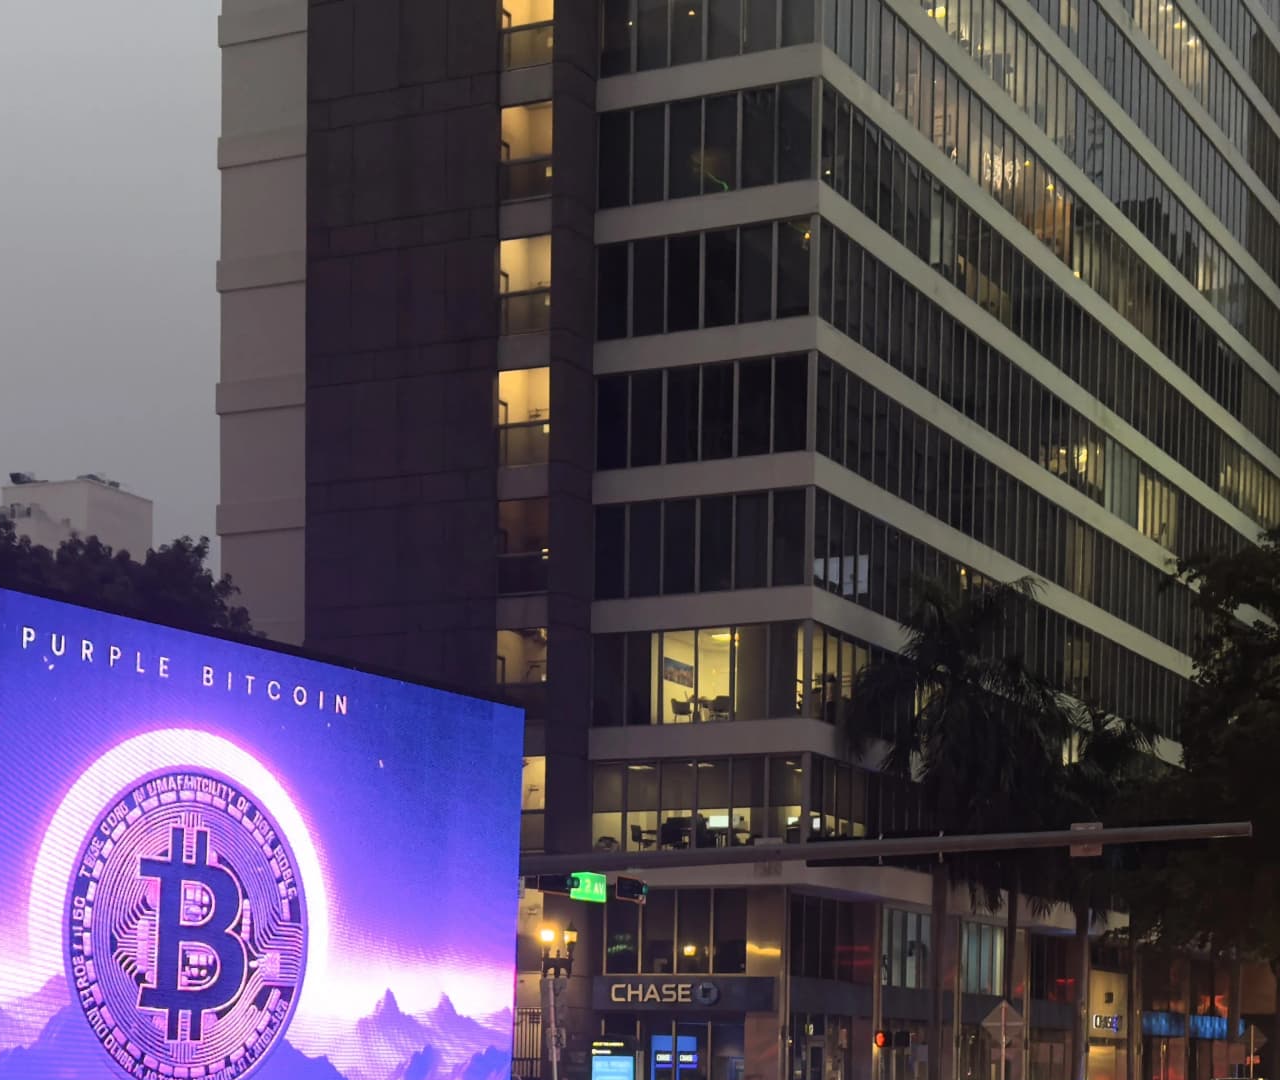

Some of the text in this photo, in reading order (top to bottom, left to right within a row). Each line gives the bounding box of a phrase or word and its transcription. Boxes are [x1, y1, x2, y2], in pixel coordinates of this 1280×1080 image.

[22, 626, 348, 715] PURPLE BITCOIN
[611, 983, 692, 1002] CHASE
